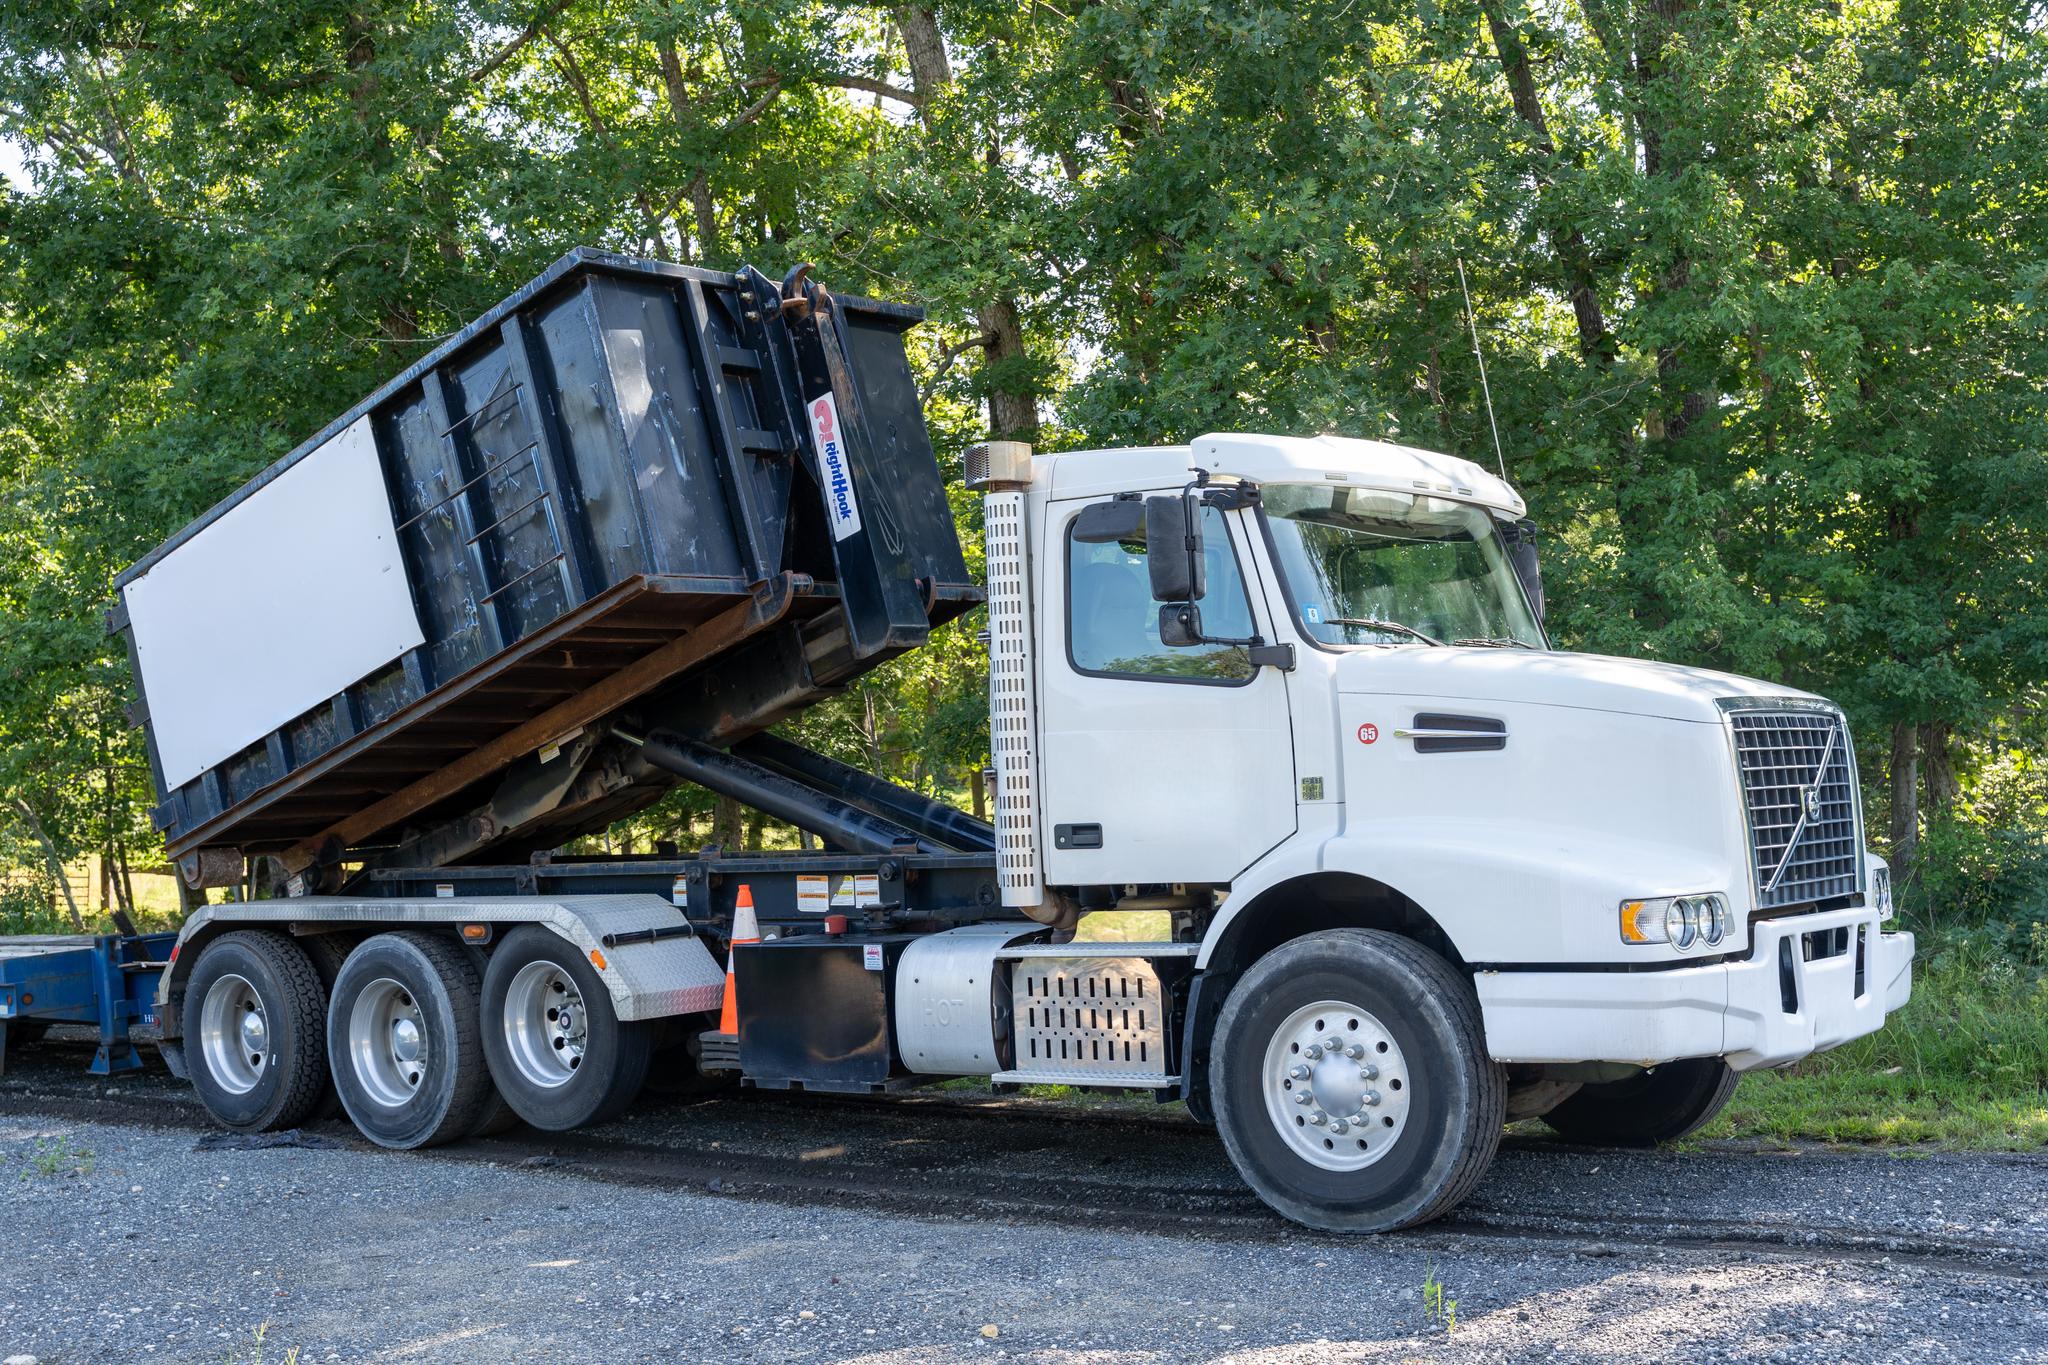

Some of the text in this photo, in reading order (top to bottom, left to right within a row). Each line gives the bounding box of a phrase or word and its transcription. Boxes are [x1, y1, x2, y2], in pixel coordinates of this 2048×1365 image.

[825, 442, 852, 520] RightHook
[1360, 727, 1376, 741] 65
[921, 998, 964, 1027] HOT
